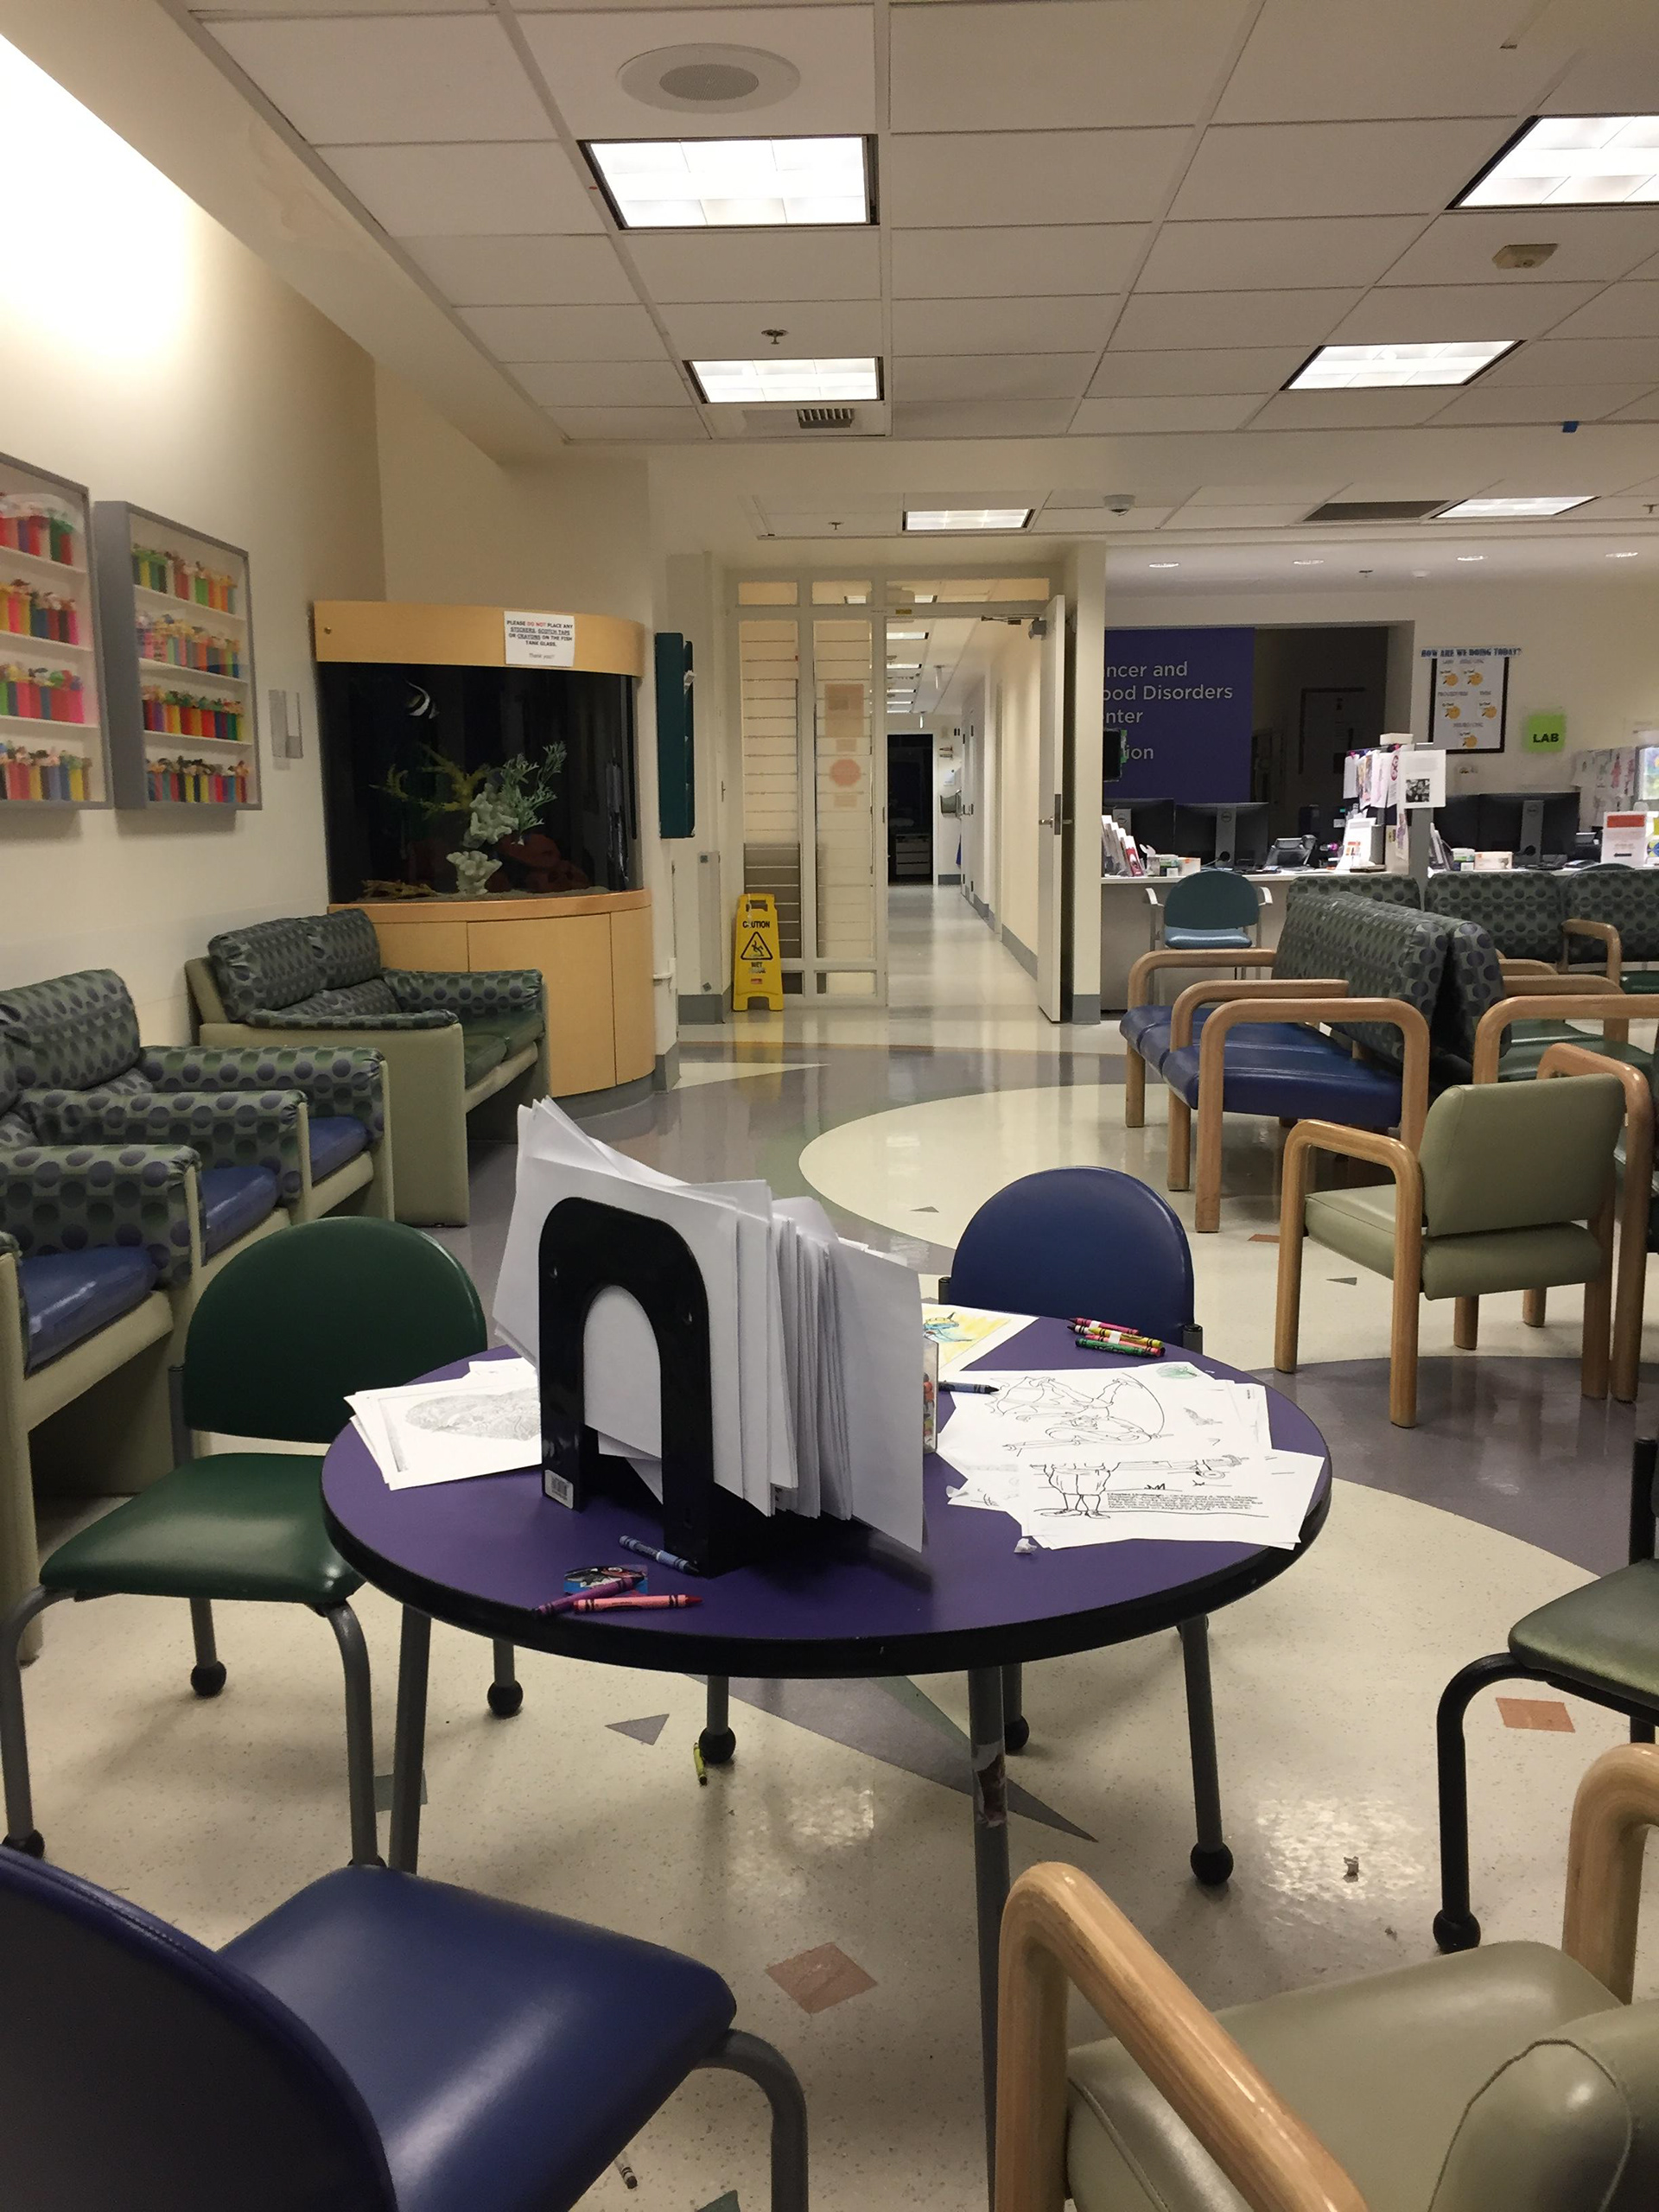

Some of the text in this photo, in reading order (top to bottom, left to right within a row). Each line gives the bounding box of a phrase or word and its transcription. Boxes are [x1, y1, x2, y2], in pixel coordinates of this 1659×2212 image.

[1494, 647, 1521, 656] TODAY?
[1106, 661, 1188, 677] ncer and
[1103, 684, 1233, 701] ood Disorders
[1106, 709, 1143, 723] nter
[1533, 734, 1560, 743] LAB
